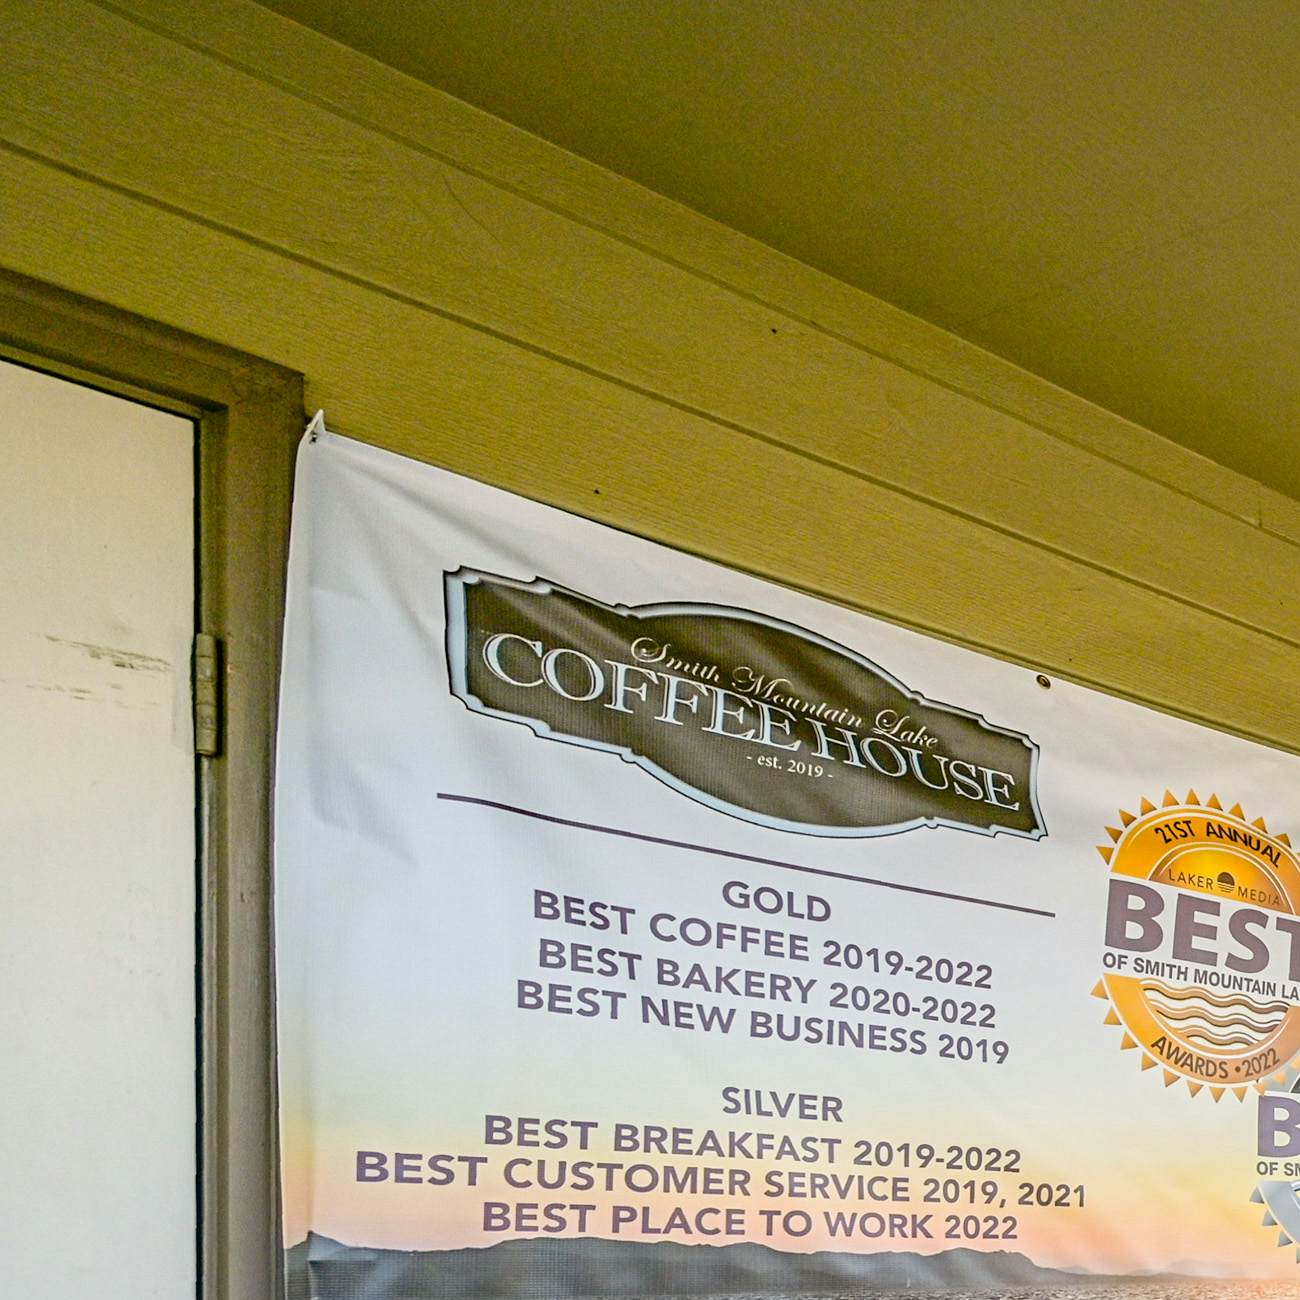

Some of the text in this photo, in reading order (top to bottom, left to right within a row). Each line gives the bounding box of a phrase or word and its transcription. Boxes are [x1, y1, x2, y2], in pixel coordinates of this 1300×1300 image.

[631, 637, 939, 751] Smith Mountain Lake
[482, 632, 1020, 812] COFFEE HOUSE
[757, 750, 824, 780] est. 2019
[1155, 820, 1281, 868] 21ST ANNUAL
[722, 880, 831, 923] GOLD
[1168, 869, 1281, 906] LAKER MEDIA
[533, 889, 993, 989] BEST COFFEE 2019-2022
[538, 938, 996, 1029] BEST BAKERY 2020-2022
[1102, 952, 1128, 970] OF
[1133, 958, 1188, 983] SMITH
[1193, 968, 1277, 997] MOUNTAIN
[516, 979, 1009, 1065] BEST NEW BUSINESS 2019
[1151, 1036, 1228, 1078] AWARDS
[721, 1086, 843, 1123] SILVER
[484, 1114, 1021, 1173] BEST BREAKFAST 2019-2022
[355, 1150, 1086, 1208] BEST CUSTOMER SERVICE 2019, 2021
[1256, 1162, 1279, 1176] OF
[482, 1201, 1018, 1240] BEST PLACE TO WORK 2022
